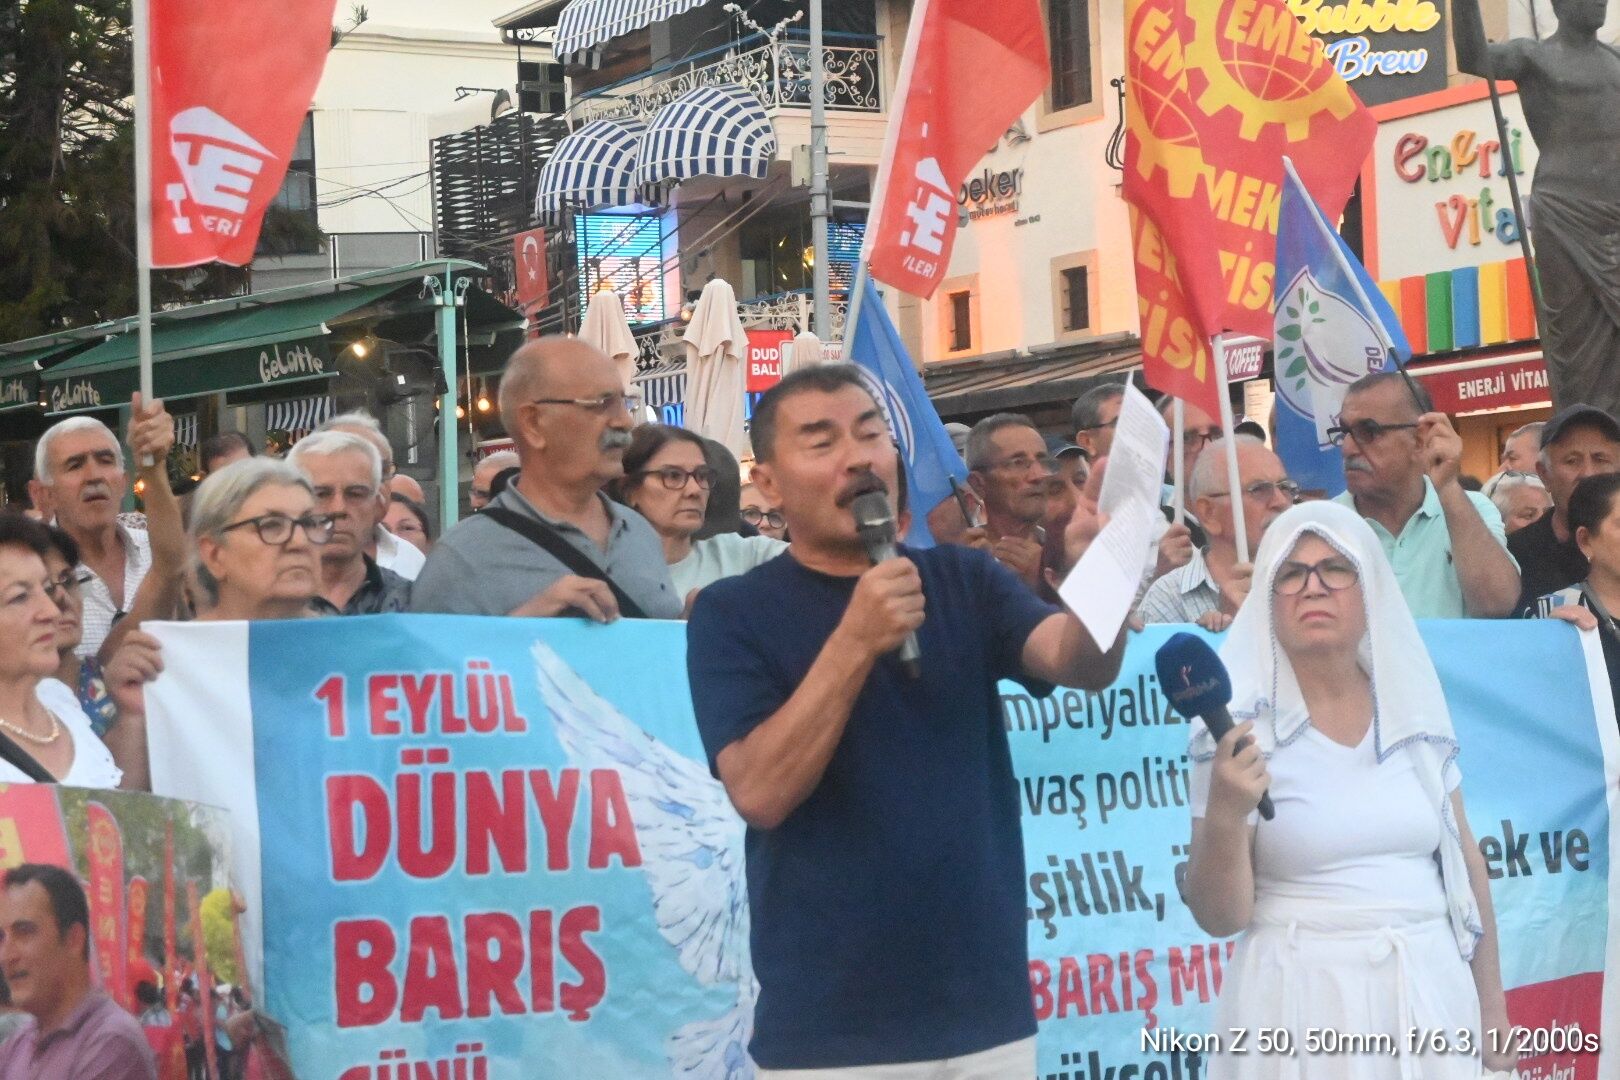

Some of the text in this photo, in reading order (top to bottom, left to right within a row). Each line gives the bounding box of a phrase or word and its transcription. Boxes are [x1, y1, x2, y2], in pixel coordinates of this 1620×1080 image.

[1323, 36, 1428, 82] Brew
[1229, 345, 1261, 376] COFFEE
[1457, 371, 1506, 400] ENERJİ
[314, 661, 527, 736] 1 EYLÜL
[326, 748, 642, 881] DÜNYA
[1539, 828, 1590, 874] ve
[1027, 850, 1165, 939] şitlik,
[334, 905, 606, 1028] BARIŞ
[1028, 948, 1158, 1030] BARIŞ
